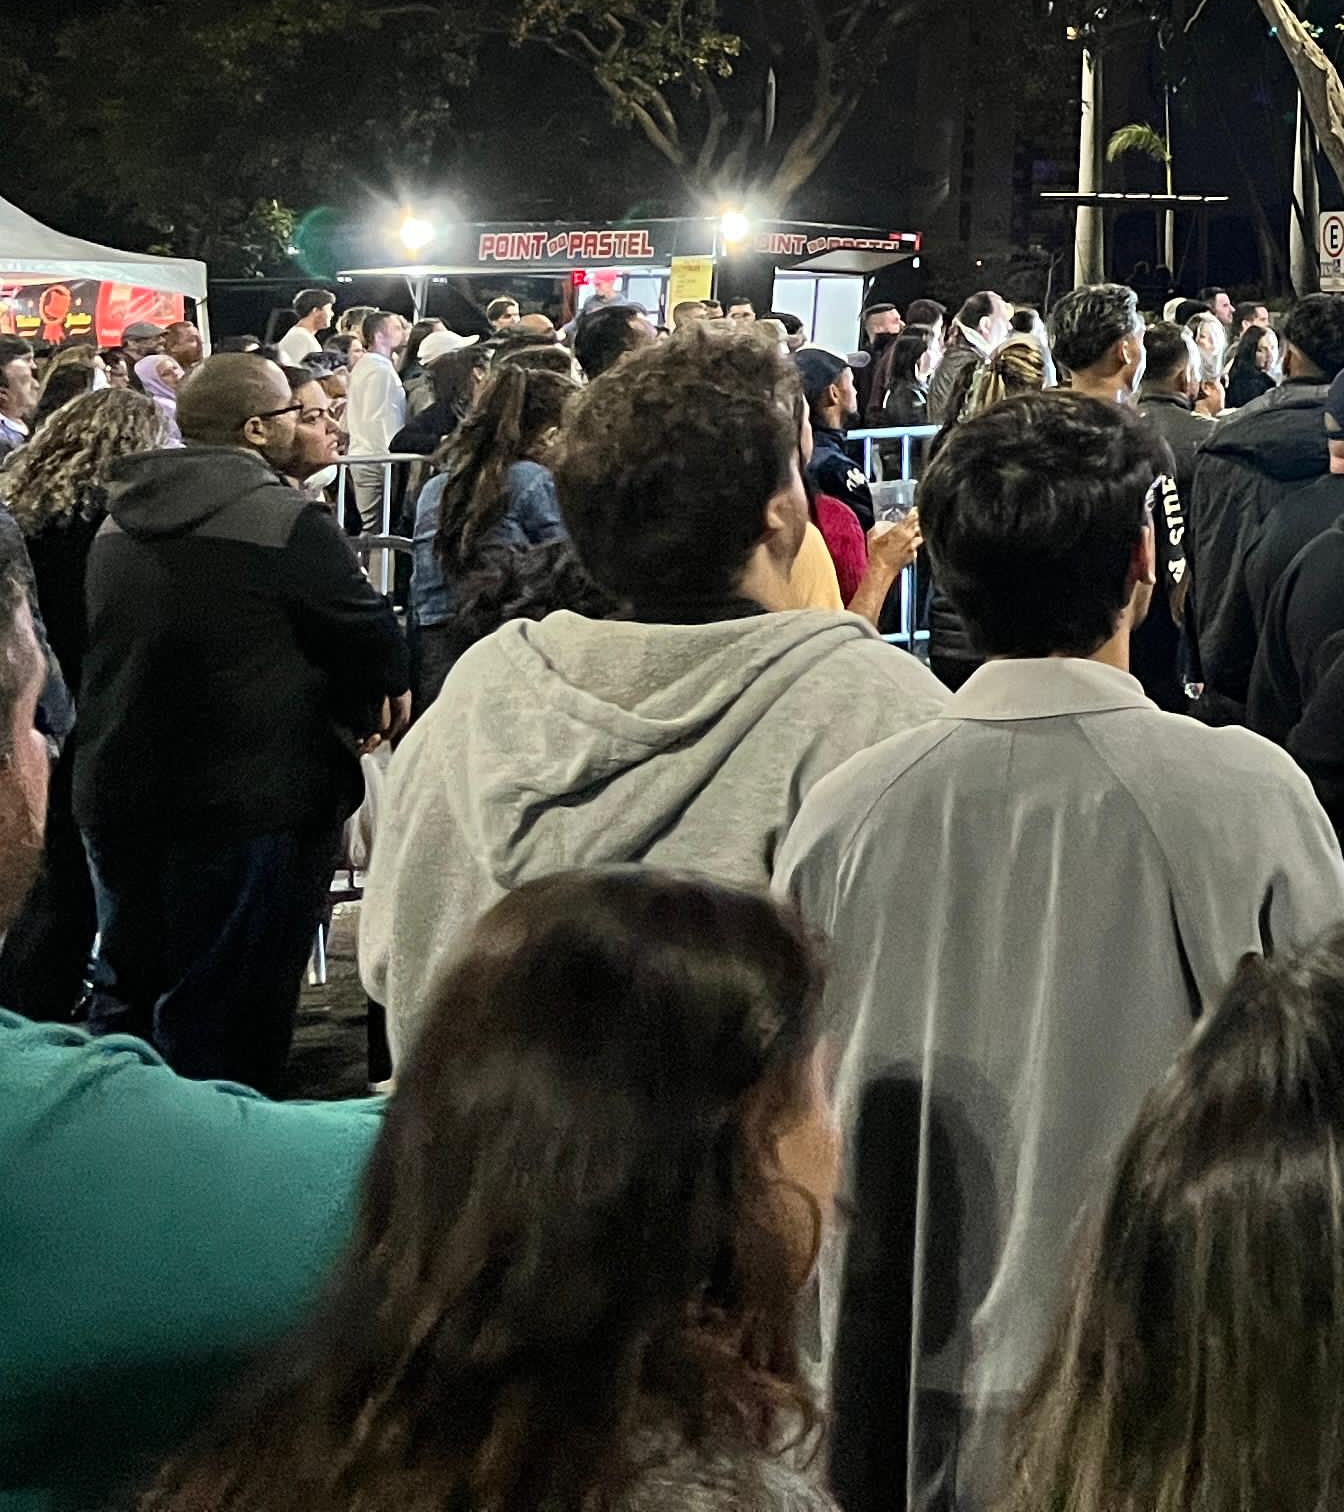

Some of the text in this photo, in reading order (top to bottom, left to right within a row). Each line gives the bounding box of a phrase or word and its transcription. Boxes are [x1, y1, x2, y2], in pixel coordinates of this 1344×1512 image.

[479, 233, 547, 260] POINT
[567, 230, 654, 258] PASTEL
[1330, 224, 1339, 249] E
